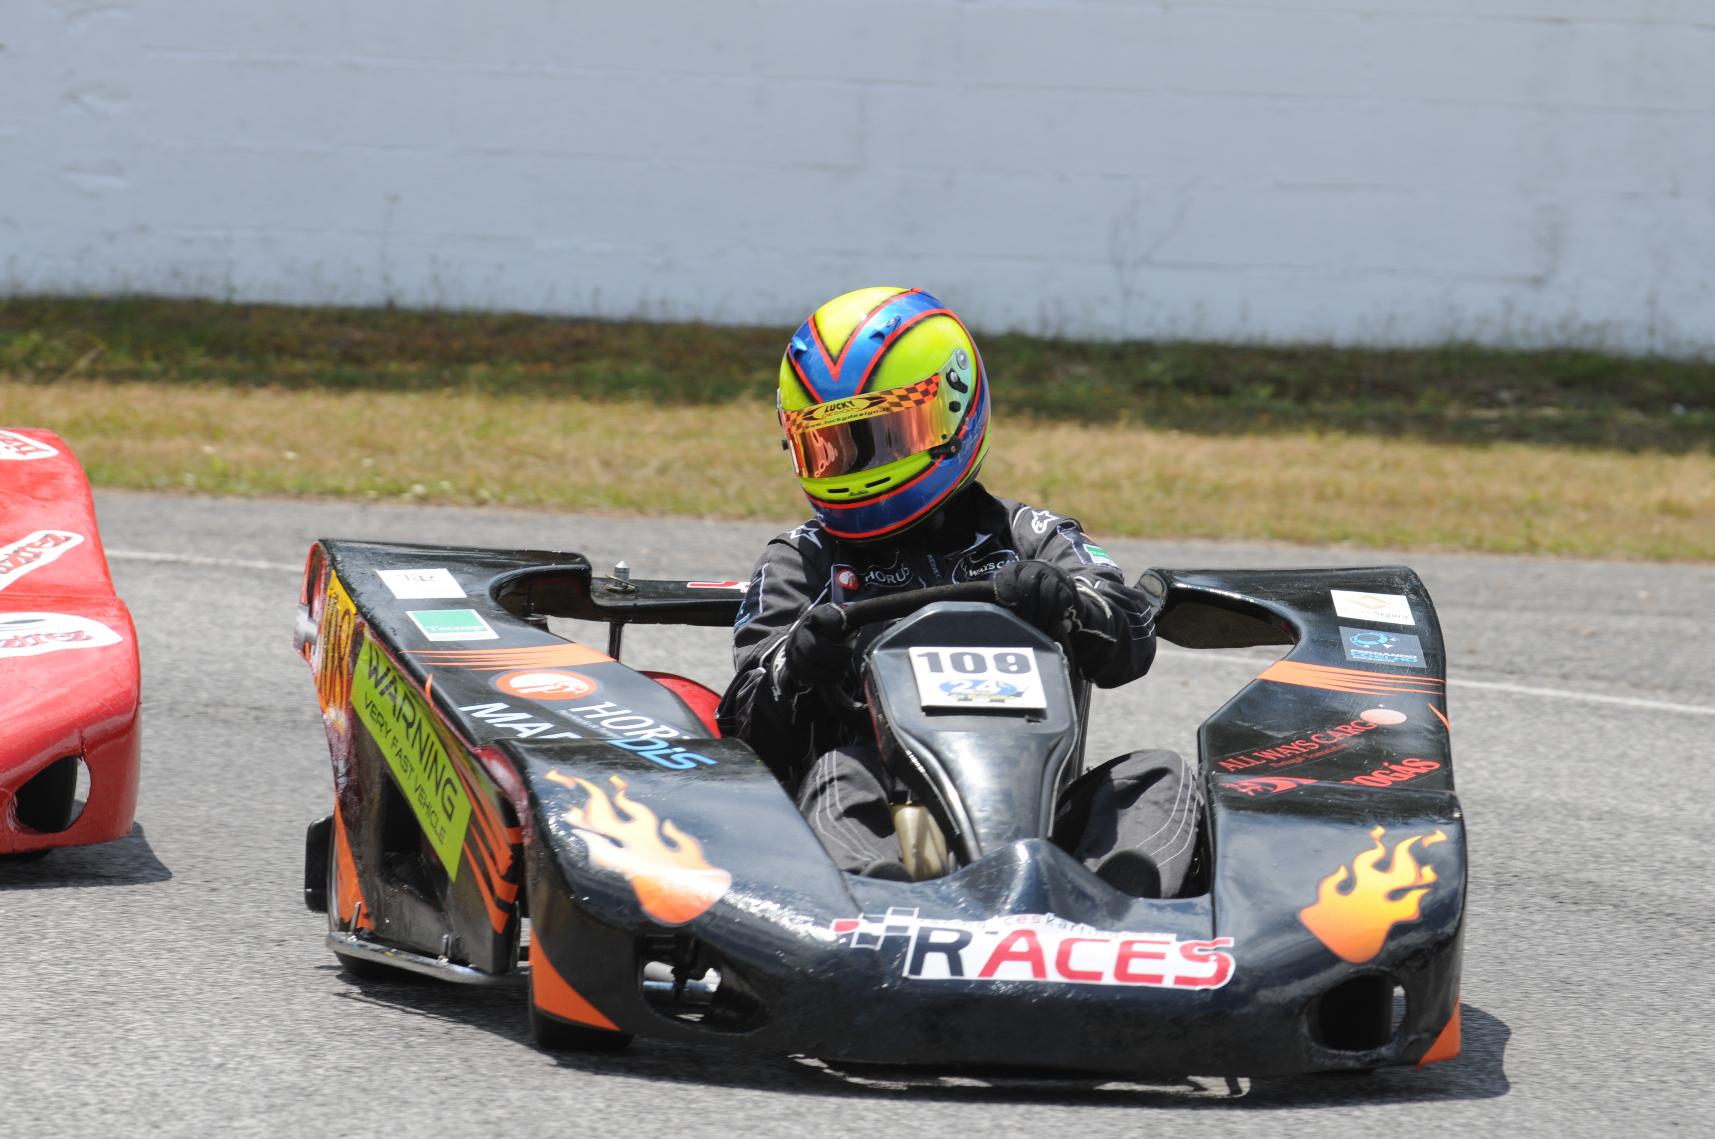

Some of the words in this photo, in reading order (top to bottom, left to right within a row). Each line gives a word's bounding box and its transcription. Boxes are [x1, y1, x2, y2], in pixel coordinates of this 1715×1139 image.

[824, 400, 856, 413] LUCKY
[917, 651, 1032, 675] 109
[367, 641, 459, 822] WARNING
[364, 691, 391, 739] VERY
[390, 736, 416, 781] FAST
[414, 770, 448, 846] VEHICLE
[907, 927, 1233, 989] RACES
